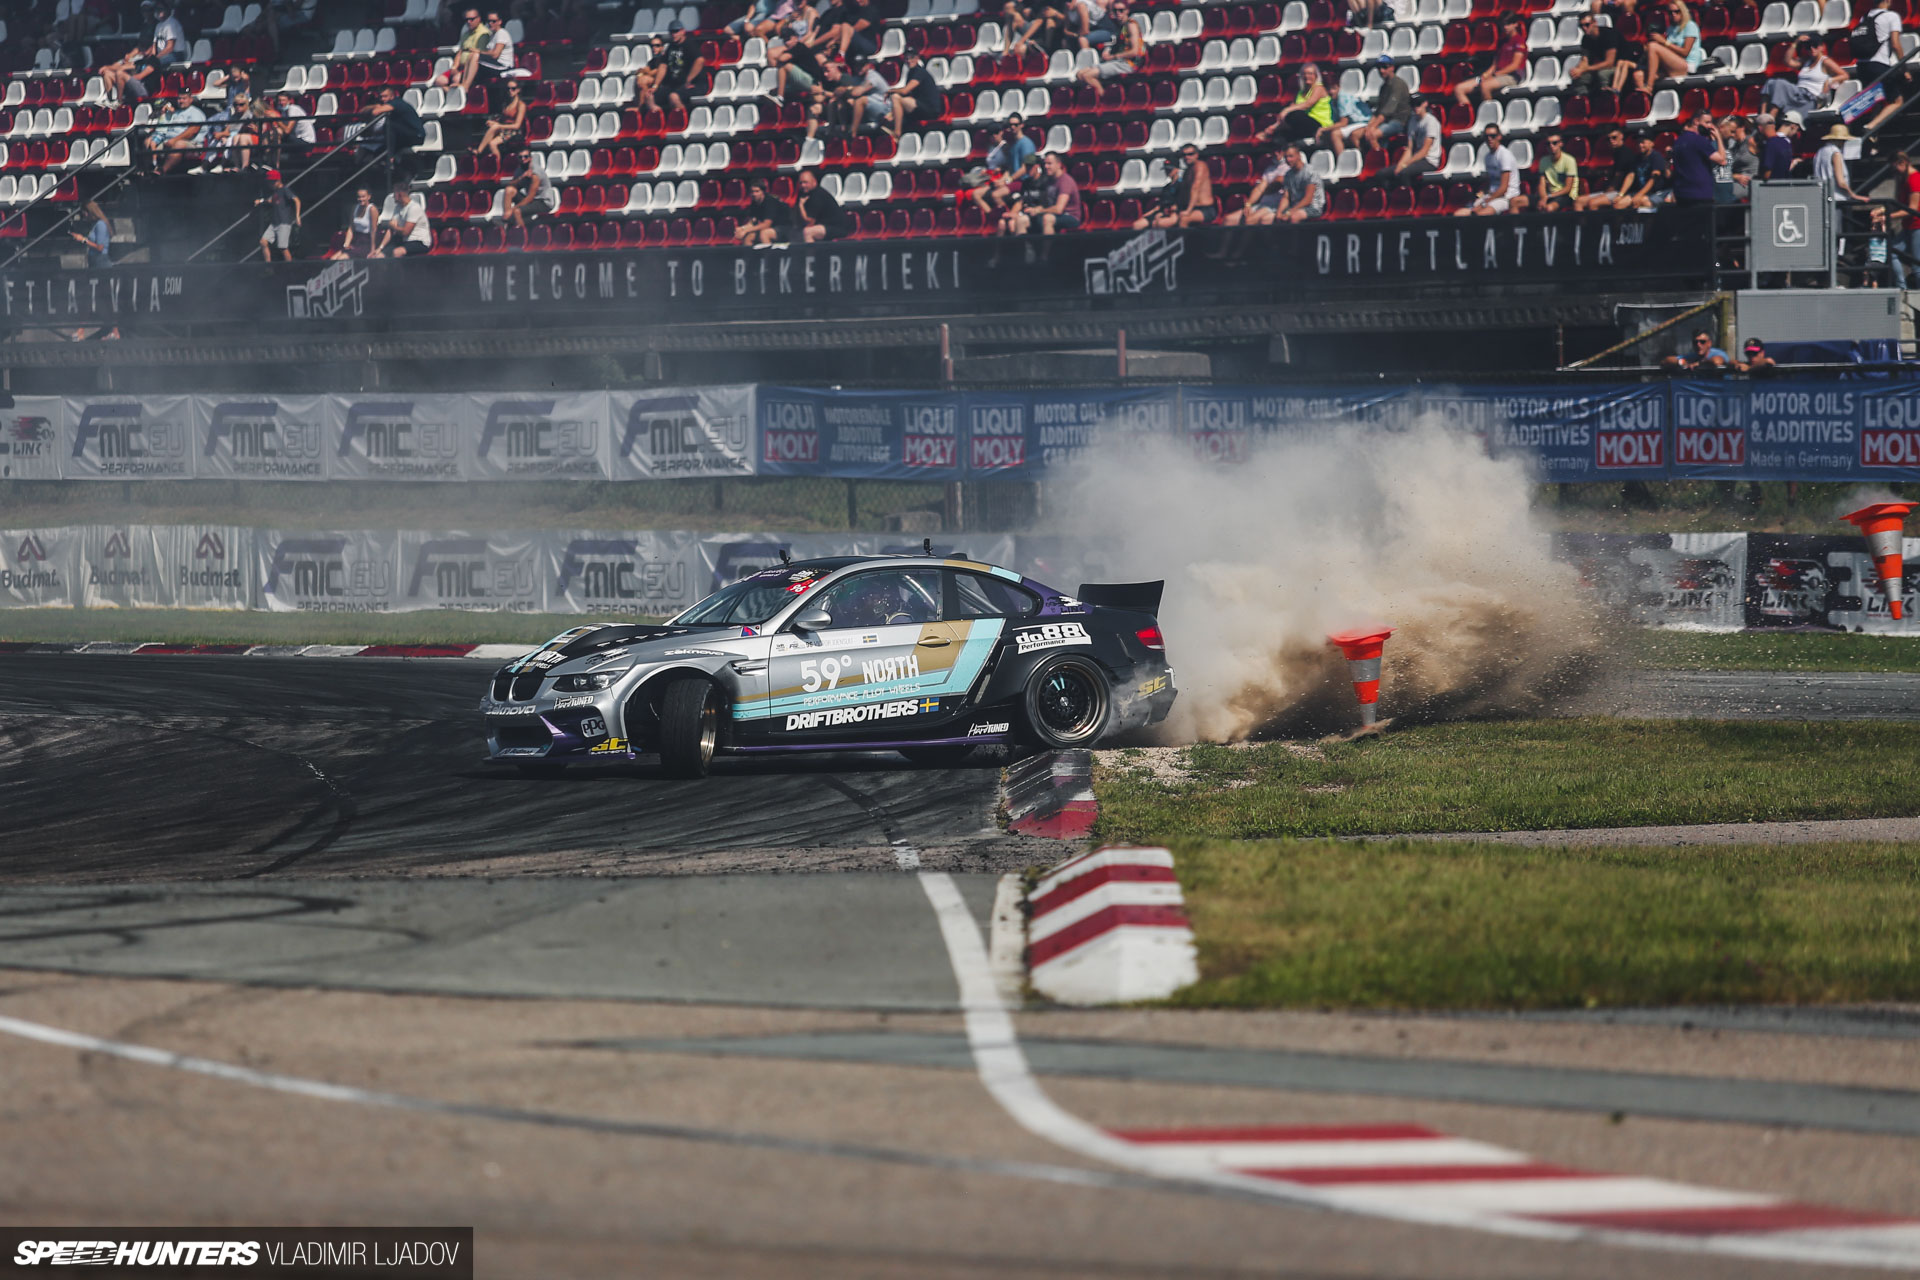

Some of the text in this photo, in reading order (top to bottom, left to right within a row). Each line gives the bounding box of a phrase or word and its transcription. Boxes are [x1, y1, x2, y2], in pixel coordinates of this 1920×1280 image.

[478, 251, 959, 301] WELCOME TO BIKERNIEKI
[1034, 404, 1077, 423] MOTOR
[1189, 402, 1244, 429] LIQUI
[1253, 398, 1305, 418] MOTOR
[1495, 398, 1548, 418] MOTOR
[1600, 399, 1660, 430] LIQUI
[1678, 397, 1741, 427] LIQUI
[1751, 392, 1854, 415] MOTOR OILS
[767, 404, 815, 429] LIQUI
[904, 407, 954, 434] LIQUI
[972, 407, 1022, 434] LIQUI
[1505, 424, 1590, 446] ADDITIVES
[1751, 421, 1854, 443] & ADDITIVES
[764, 434, 817, 459] MOLY
[904, 437, 954, 463] MOLY
[972, 438, 1024, 464] MOLY
[1600, 433, 1662, 464] MOLY
[1678, 432, 1744, 461] MOLY
[100, 462, 185, 475] PERFORMANCE
[233, 462, 320, 475] PERFORMANCE
[651, 457, 746, 473] PERFORMANCE
[1540, 454, 1590, 472] Germany
[1751, 451, 1853, 471] Made in Germany
[1867, 597, 1915, 612] LIK
[1016, 624, 1081, 645] do88
[1021, 639, 1066, 650] Performance
[800, 654, 853, 693] 59°
[803, 682, 921, 707] PERFORMANCE ALLOY WHEELS
[786, 699, 919, 731] DRIFTBROTHERS
